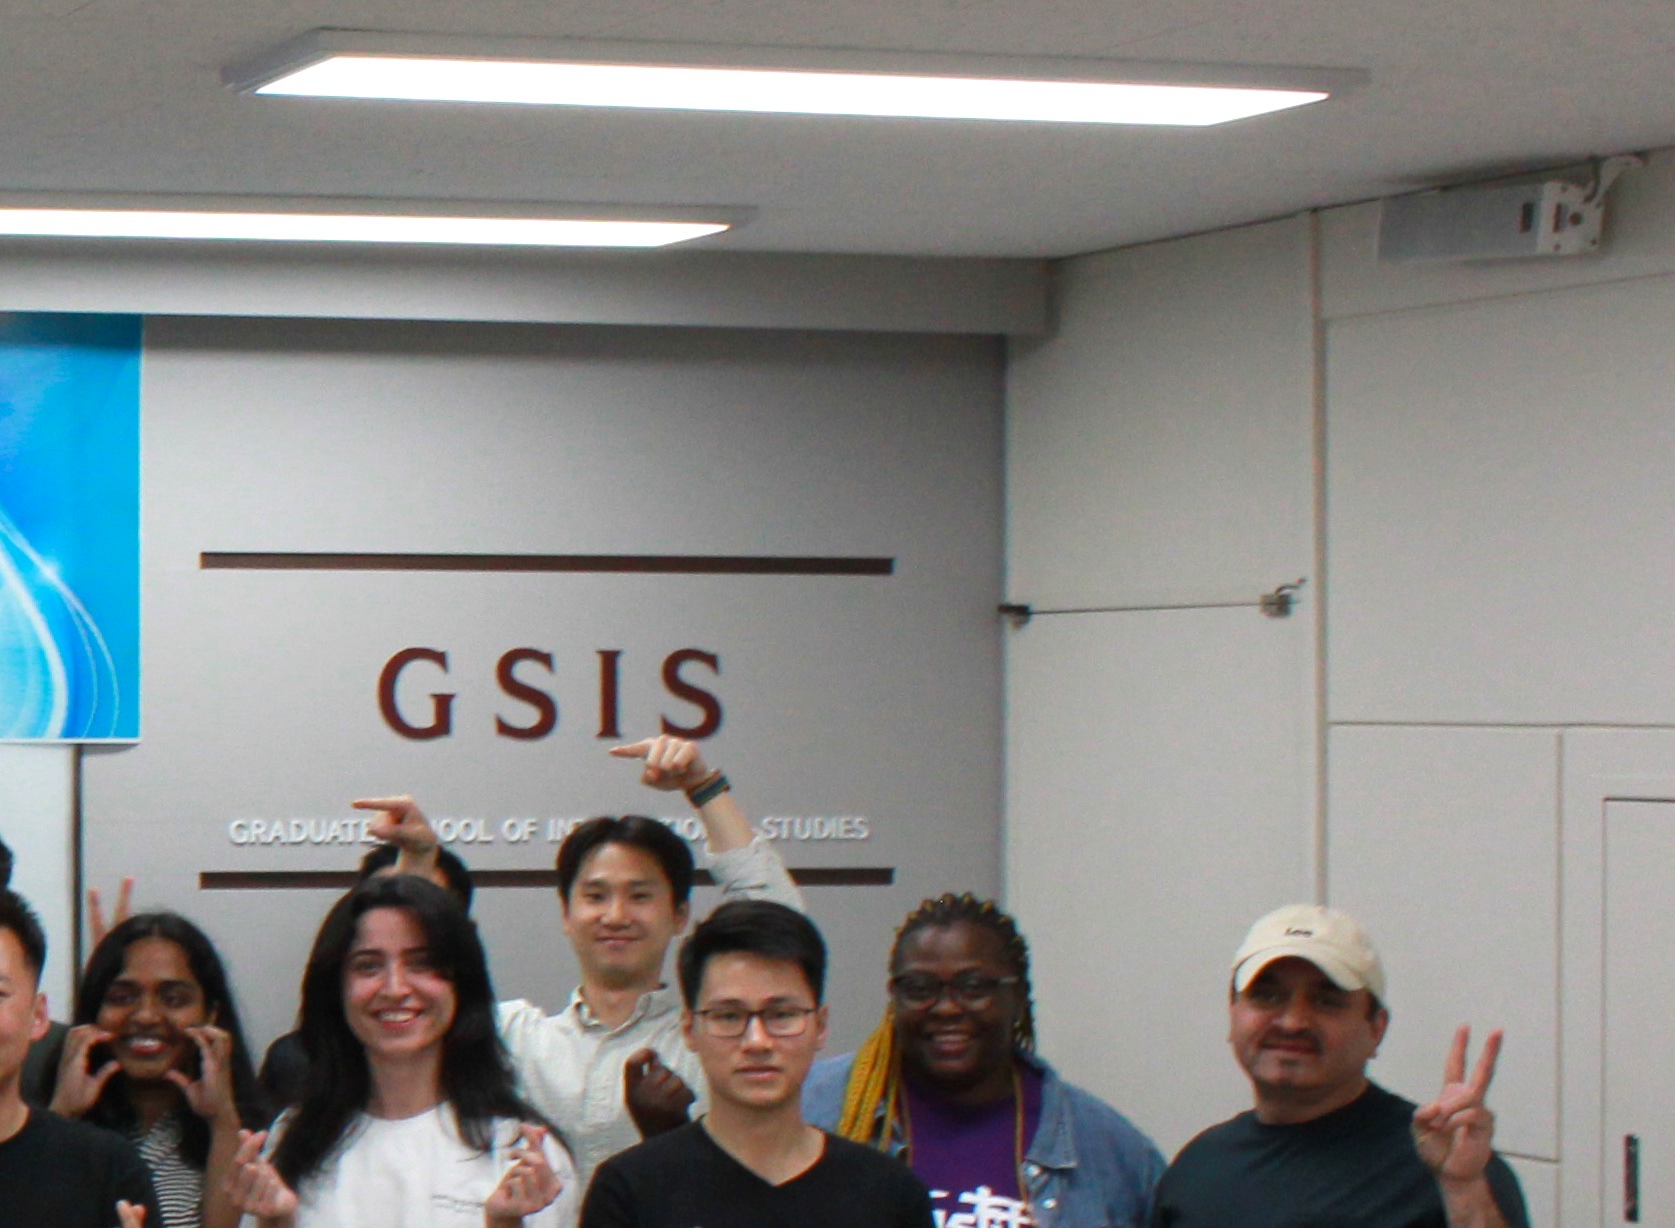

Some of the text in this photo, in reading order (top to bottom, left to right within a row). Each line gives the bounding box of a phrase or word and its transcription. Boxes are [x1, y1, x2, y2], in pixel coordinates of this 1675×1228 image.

[377, 646, 724, 741] GSIS
[503, 818, 540, 843] OF
[761, 816, 872, 841] STUDIES
